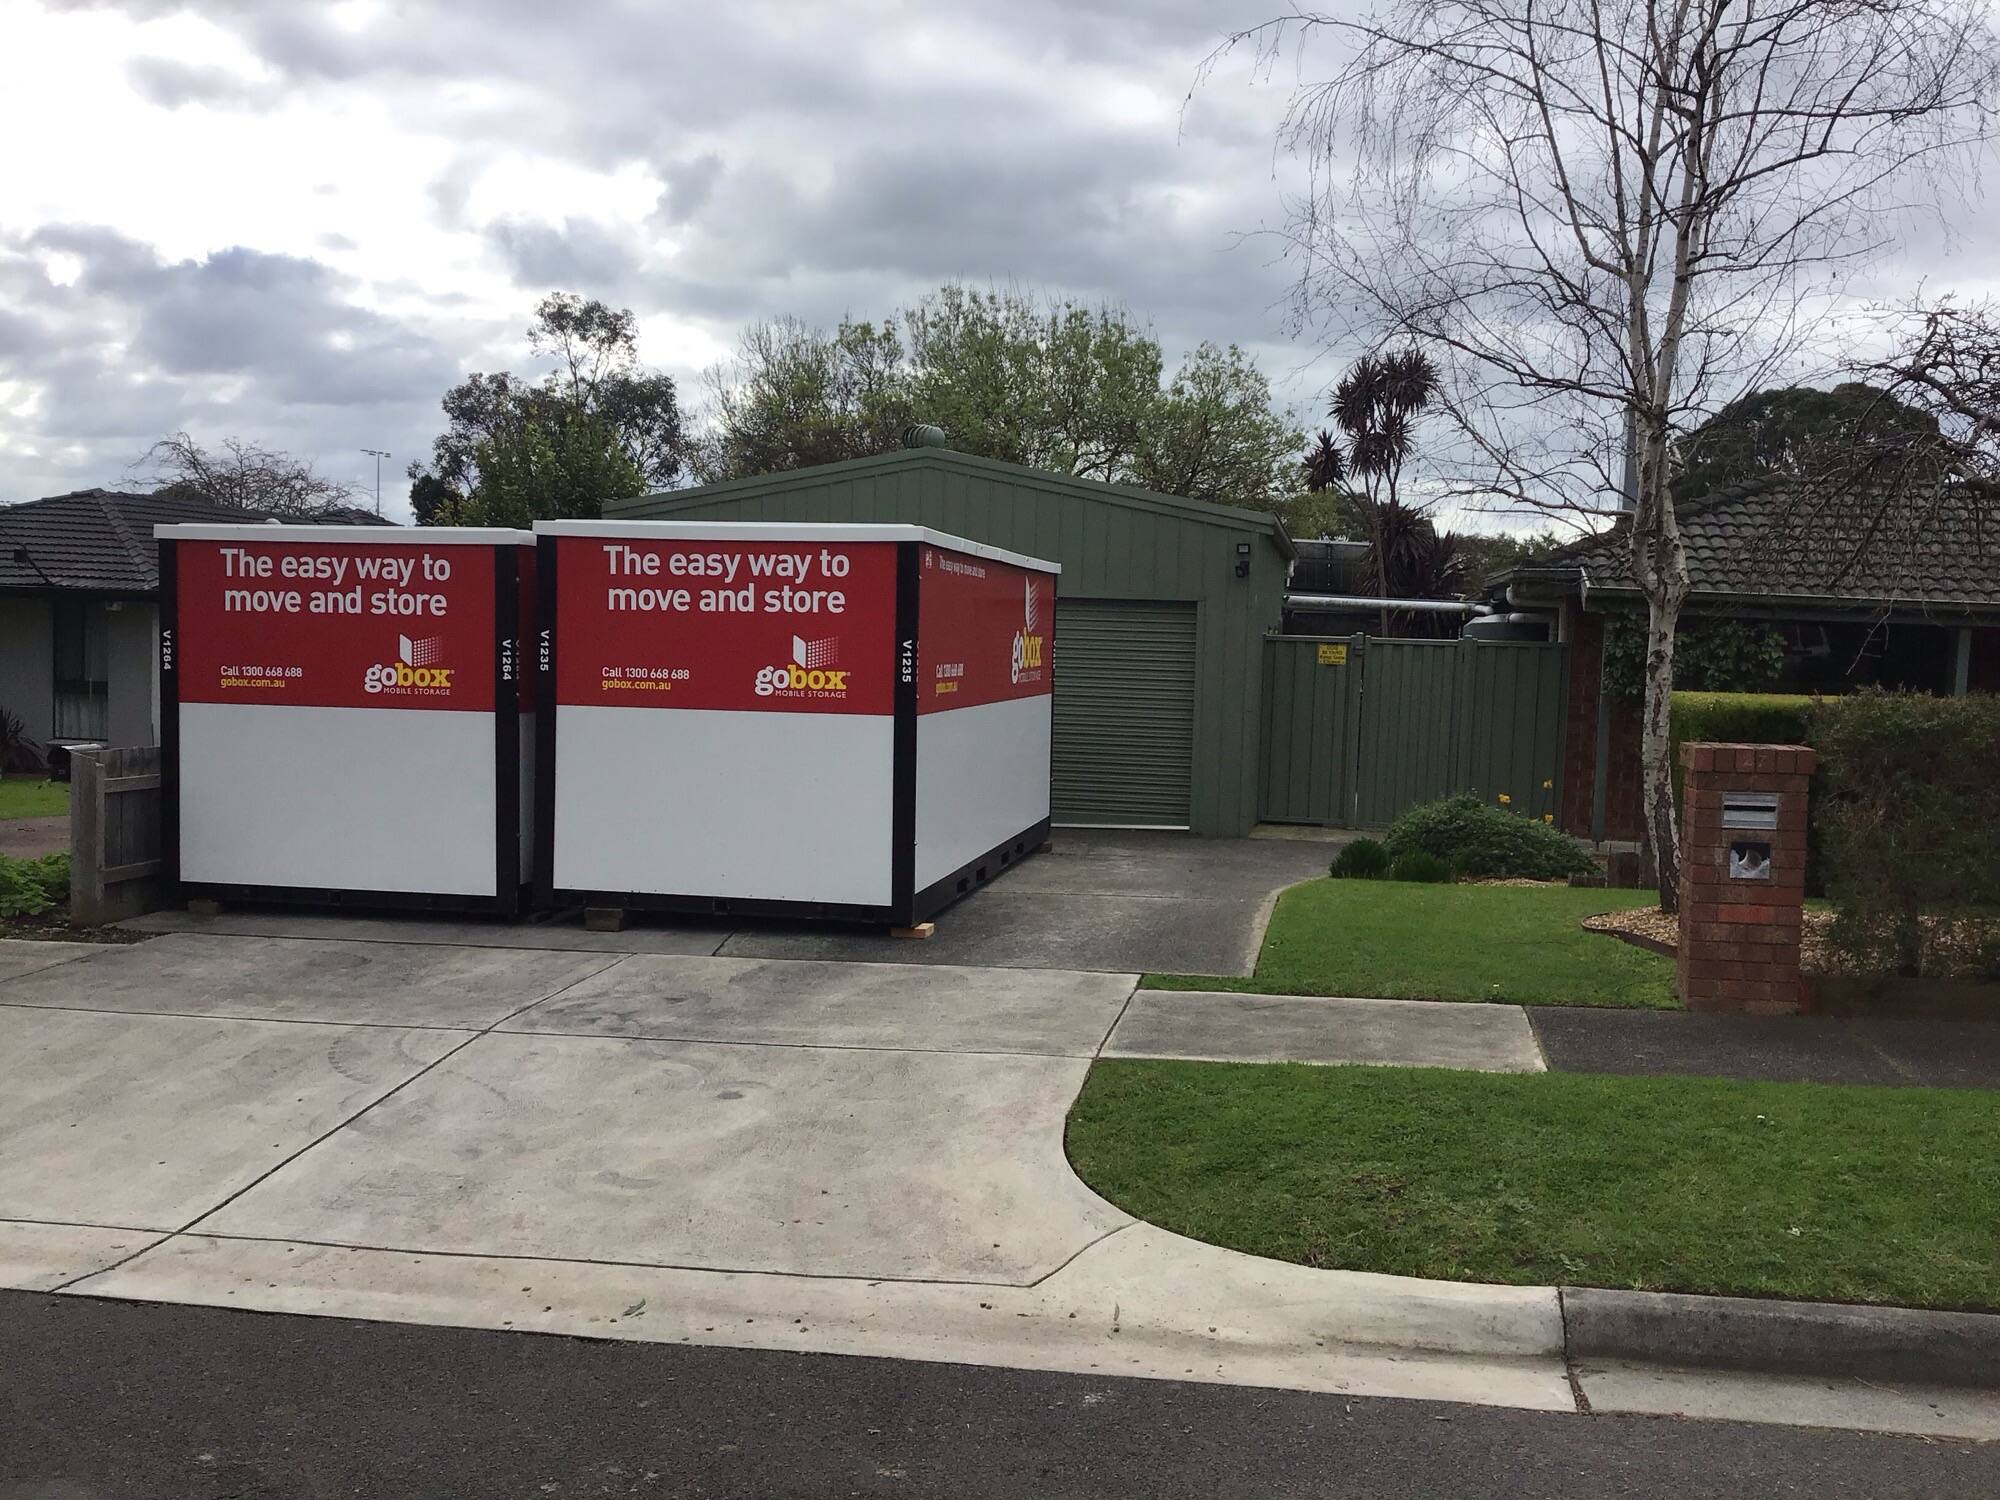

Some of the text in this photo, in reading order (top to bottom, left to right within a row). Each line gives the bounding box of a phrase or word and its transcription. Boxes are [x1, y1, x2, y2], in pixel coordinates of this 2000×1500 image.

[220, 549, 450, 587] The easy way to
[603, 546, 849, 584] The easy way to
[225, 586, 447, 616] move and store
[609, 583, 845, 613] move and store
[163, 630, 171, 669] V1264
[503, 640, 511, 680] V1264
[540, 630, 549, 671] V1235
[903, 640, 912, 682] V1235
[1011, 627, 1043, 685] gobox
[221, 665, 302, 678] Call 1300 668 688
[221, 677, 285, 688] gobox.com.au
[365, 663, 450, 692] gobox
[602, 678, 671, 690] gobox.com.au
[603, 666, 689, 680] Call 1300 668 688
[755, 664, 847, 696] gobox
[808, 690, 847, 698] STORAGE
